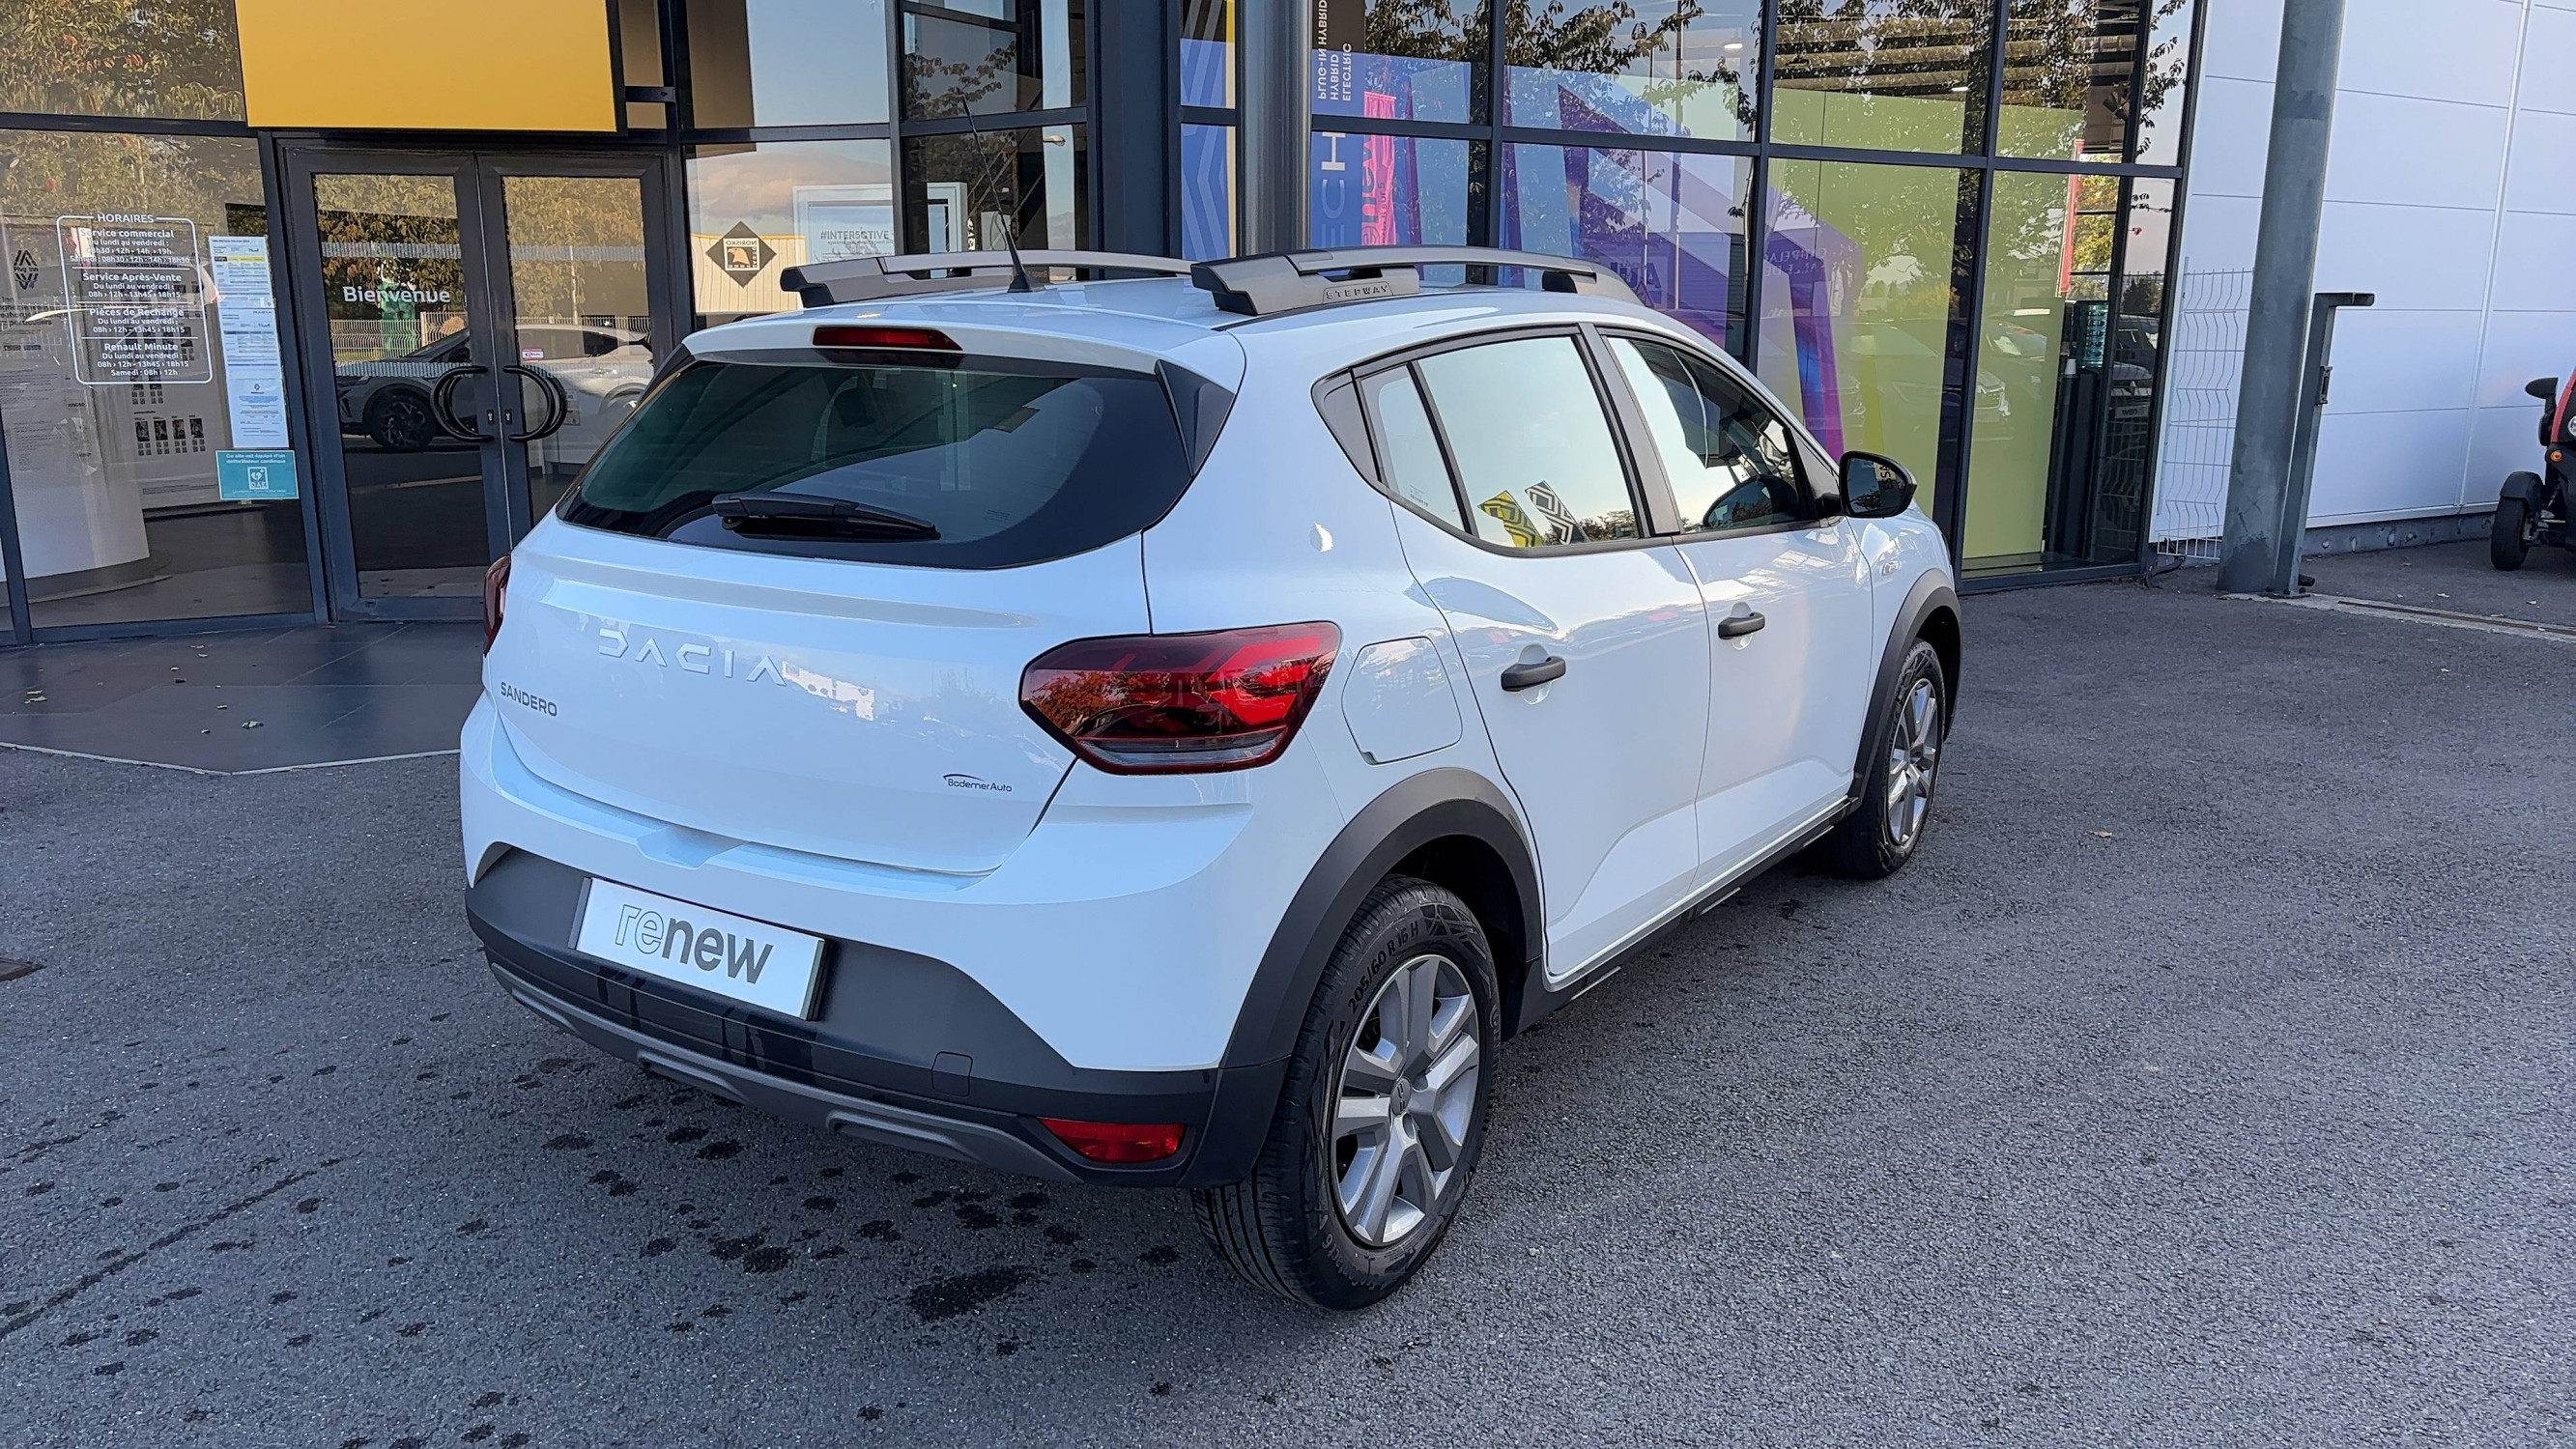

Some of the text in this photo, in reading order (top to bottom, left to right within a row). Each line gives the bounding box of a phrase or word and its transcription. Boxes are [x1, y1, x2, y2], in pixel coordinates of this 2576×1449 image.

[97, 213, 155, 223] HORAIRES
[80, 228, 175, 239] Service commercial
[131, 239, 165, 247] vendredi
[82, 272, 183, 283] Service Après-Vente
[342, 285, 451, 303] Bienvenue
[1326, 284, 1388, 299] STEPWAY
[137, 308, 185, 318] Rechange
[597, 627, 787, 687] DACIA
[500, 681, 558, 717] SANDERO
[615, 903, 774, 985] renew
[1347, 920, 1418, 1014] 205/60 R 16 H
